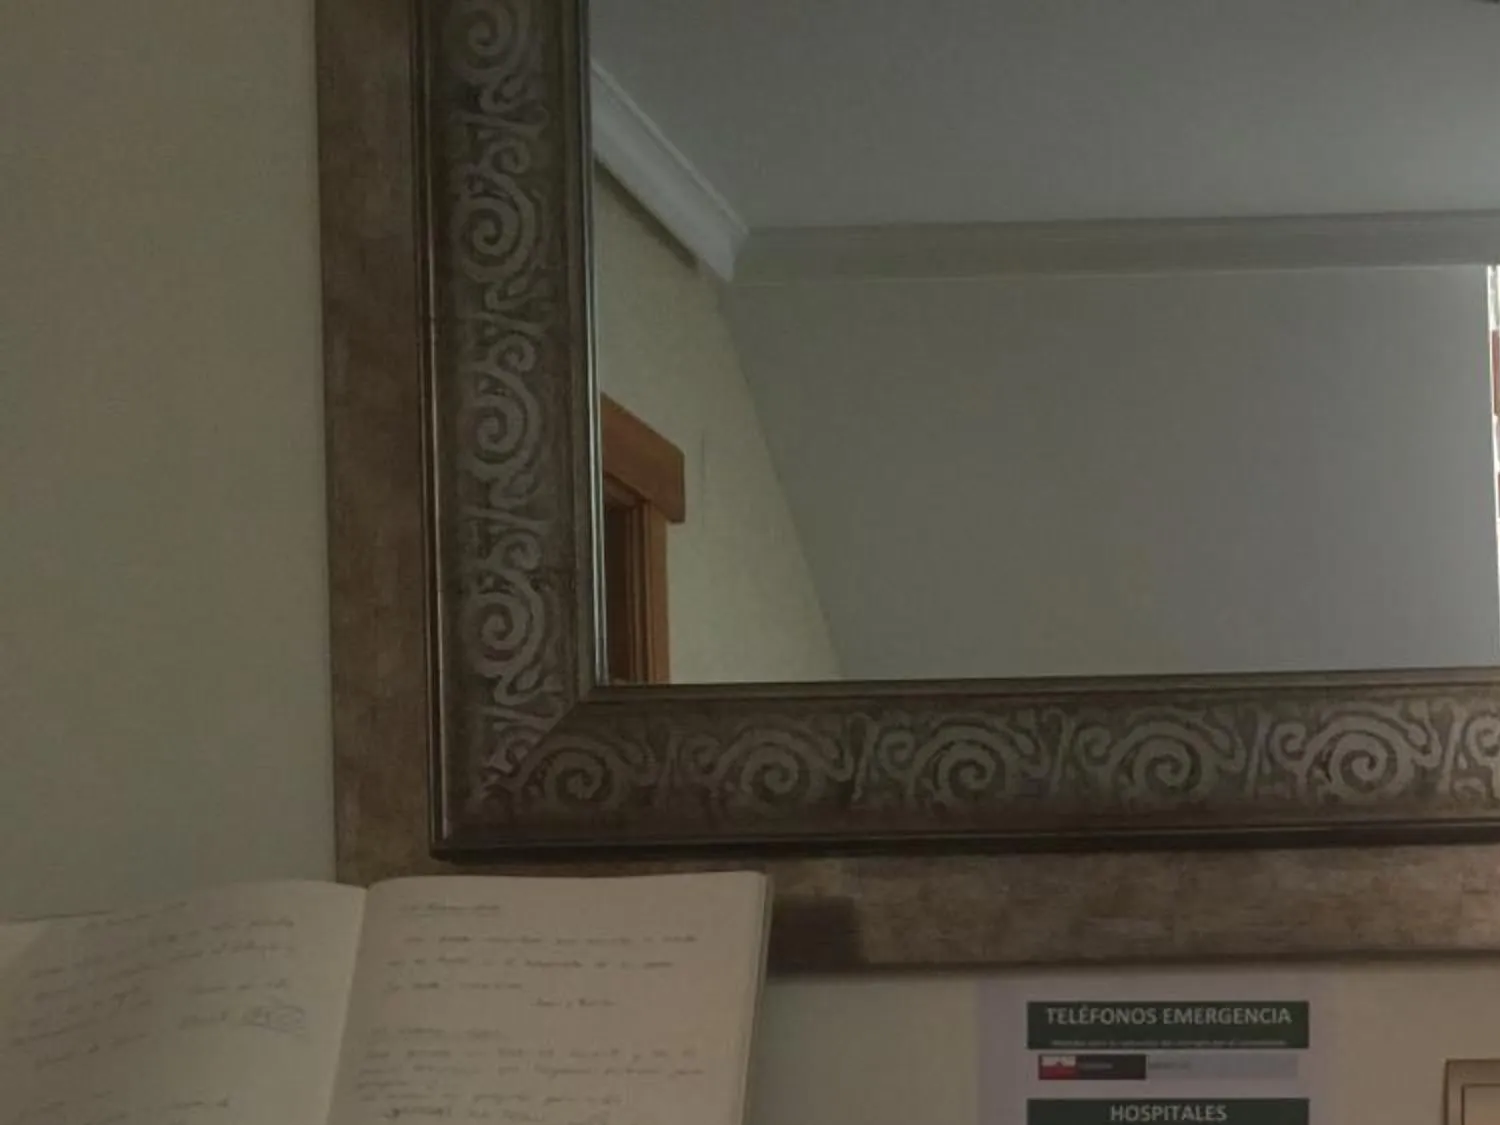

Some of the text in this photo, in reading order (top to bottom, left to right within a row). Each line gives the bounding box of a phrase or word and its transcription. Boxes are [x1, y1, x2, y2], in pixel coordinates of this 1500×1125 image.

[1046, 1004, 1293, 1025] TELÉFONOS EMERGENCIA
[1110, 1104, 1228, 1122] HOSPITALES
